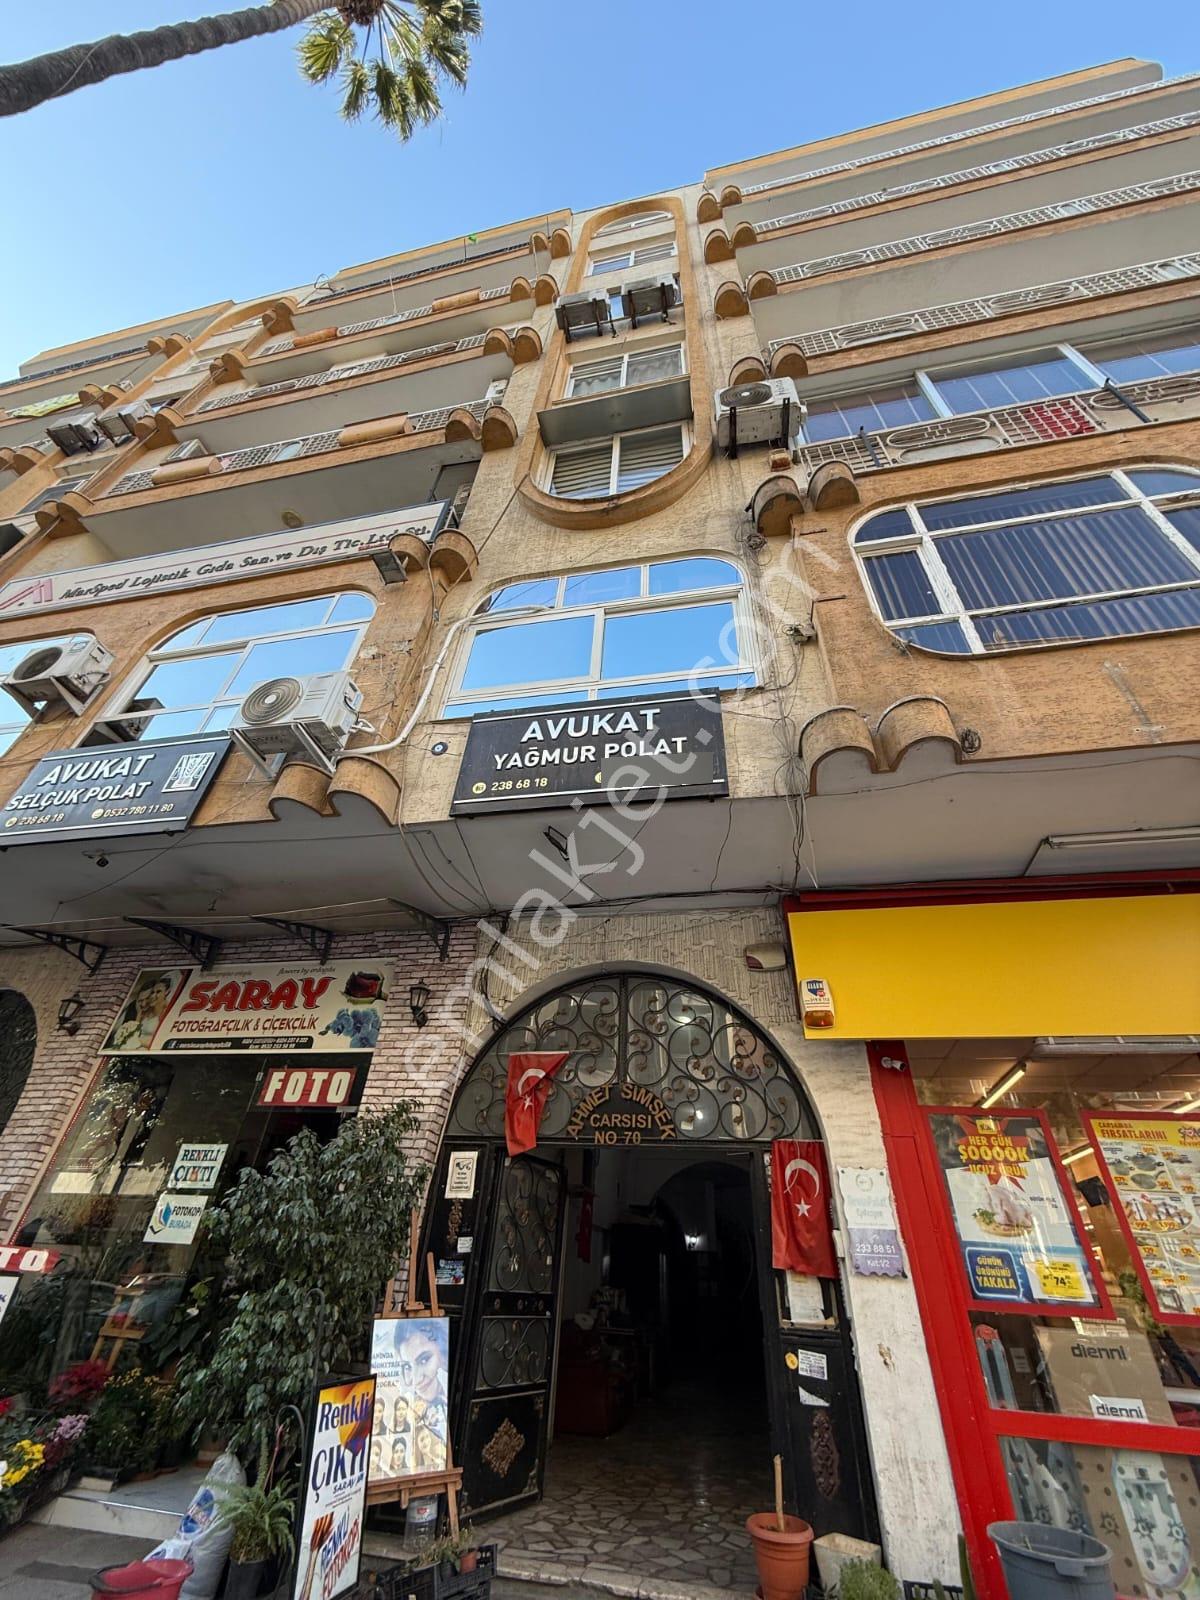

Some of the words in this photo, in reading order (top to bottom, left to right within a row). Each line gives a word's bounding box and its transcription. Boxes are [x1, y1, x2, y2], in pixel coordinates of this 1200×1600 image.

[129, 567, 191, 588] Lojistik
[520, 708, 661, 743] AVUKAT
[494, 745, 597, 771] YAĞMUR
[604, 736, 688, 759] POLAT
[37, 754, 156, 787] AVUKAT
[491, 781, 513, 792] 238
[515, 779, 531, 790] 68
[533, 777, 549, 788] 18
[5, 788, 86, 812] SELÇUK
[82, 781, 152, 803] POLAT
[178, 976, 337, 1016] SARAY
[261, 1014, 319, 1034] ÇİÇEKÇİLİK
[264, 1071, 352, 1104] FOTO
[567, 1083, 613, 1137] AHMET
[590, 1114, 652, 1129] CARSISI
[594, 1131, 617, 1145] NO
[624, 1131, 641, 1145] 70
[968, 1135, 988, 1146] HER
[990, 1134, 1013, 1147] GÜN
[969, 1164, 997, 1175] UCUZ
[856, 1244, 871, 1253] 233
[976, 1275, 1017, 1290] YAKALA
[1071, 1343, 1128, 1360] dienni
[319, 1392, 369, 1433] Renkli
[1096, 1402, 1144, 1418] dienni
